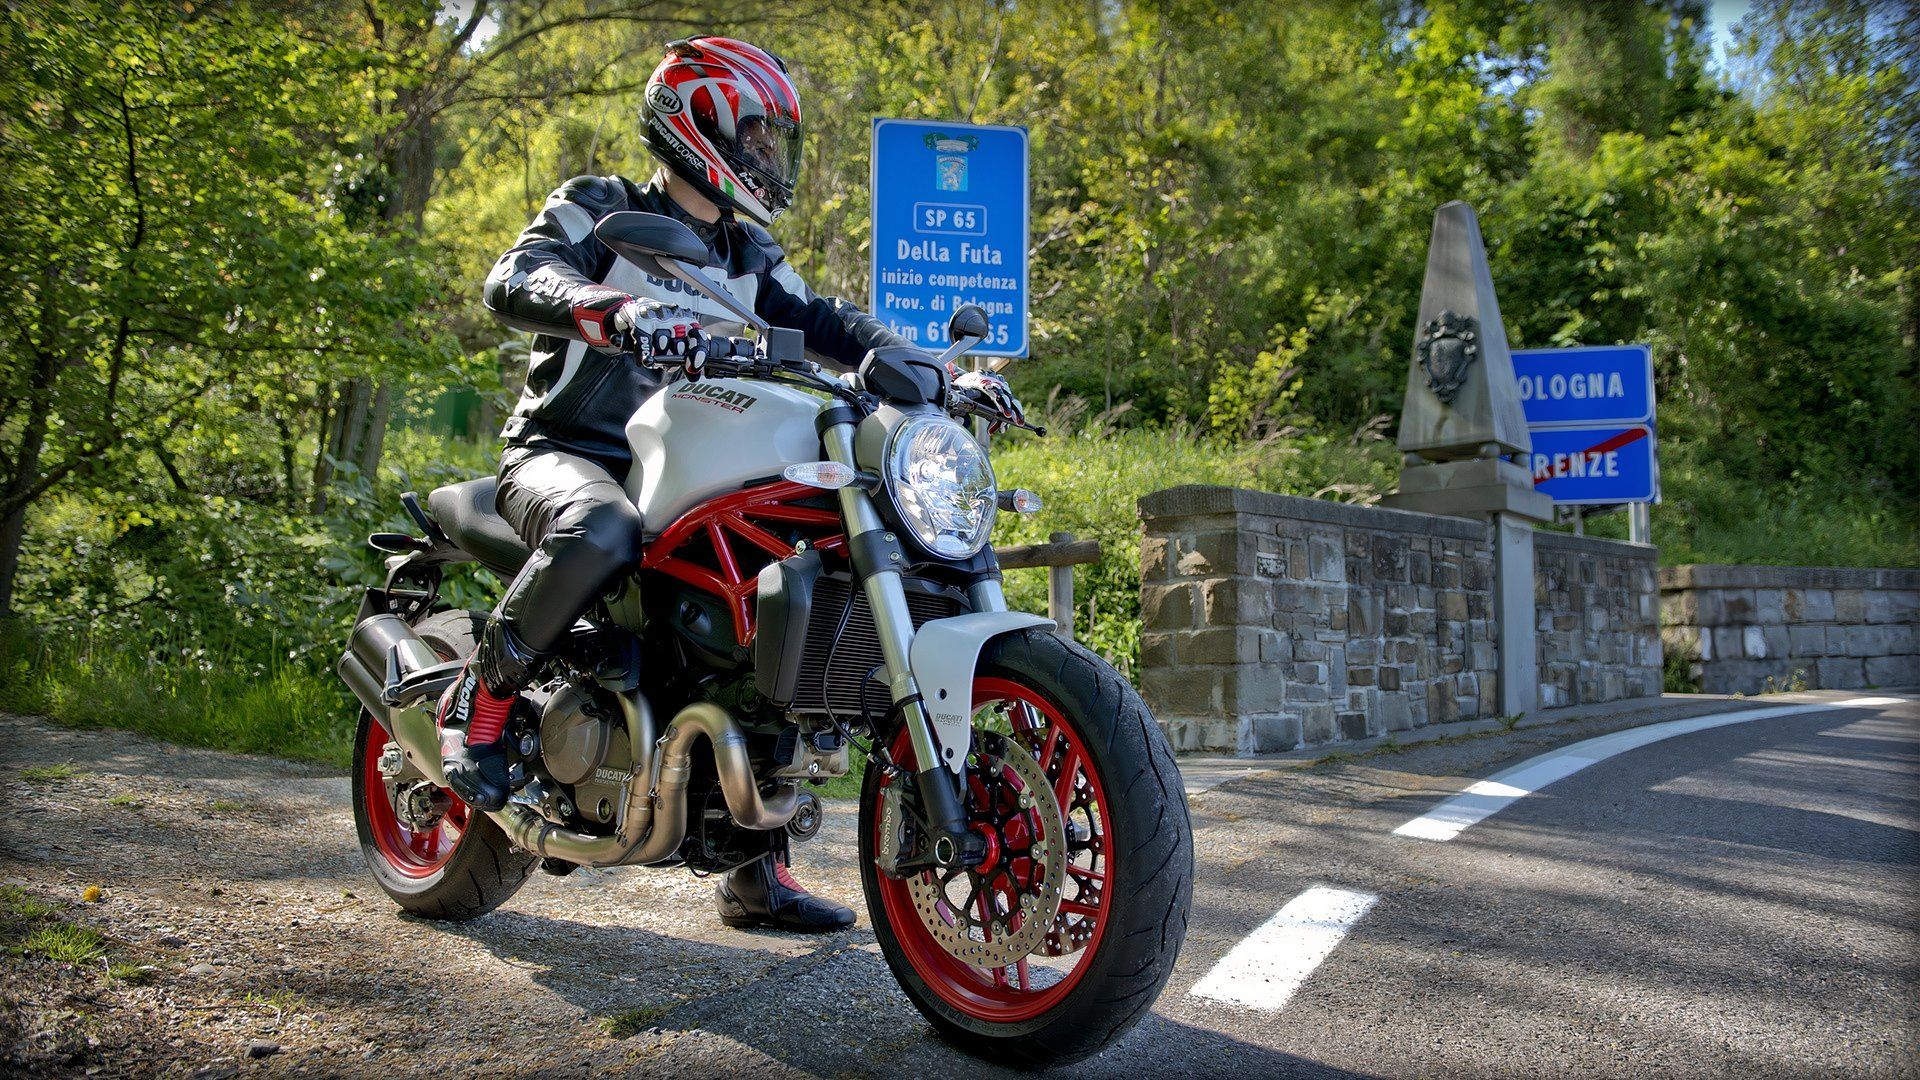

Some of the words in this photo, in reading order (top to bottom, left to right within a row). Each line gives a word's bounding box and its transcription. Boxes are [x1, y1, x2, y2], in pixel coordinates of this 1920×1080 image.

[649, 87, 678, 109] Arai
[925, 209, 947, 228] SP
[953, 210, 976, 229] 65
[897, 239, 950, 263] Della
[960, 243, 1002, 265] Futa
[882, 268, 923, 285] inizio
[928, 273, 1017, 291] competenza
[885, 292, 925, 311] Prov.
[931, 294, 945, 311] di
[952, 295, 1013, 317] Blogna
[678, 383, 757, 409] DUCATI
[1518, 372, 1625, 400] OLOGNA
[671, 394, 744, 413] MONSTER
[1533, 451, 1619, 479] RENZE
[456, 667, 477, 721] DUCATI
[936, 712, 963, 722] DUCATI
[882, 807, 892, 855] brembo
